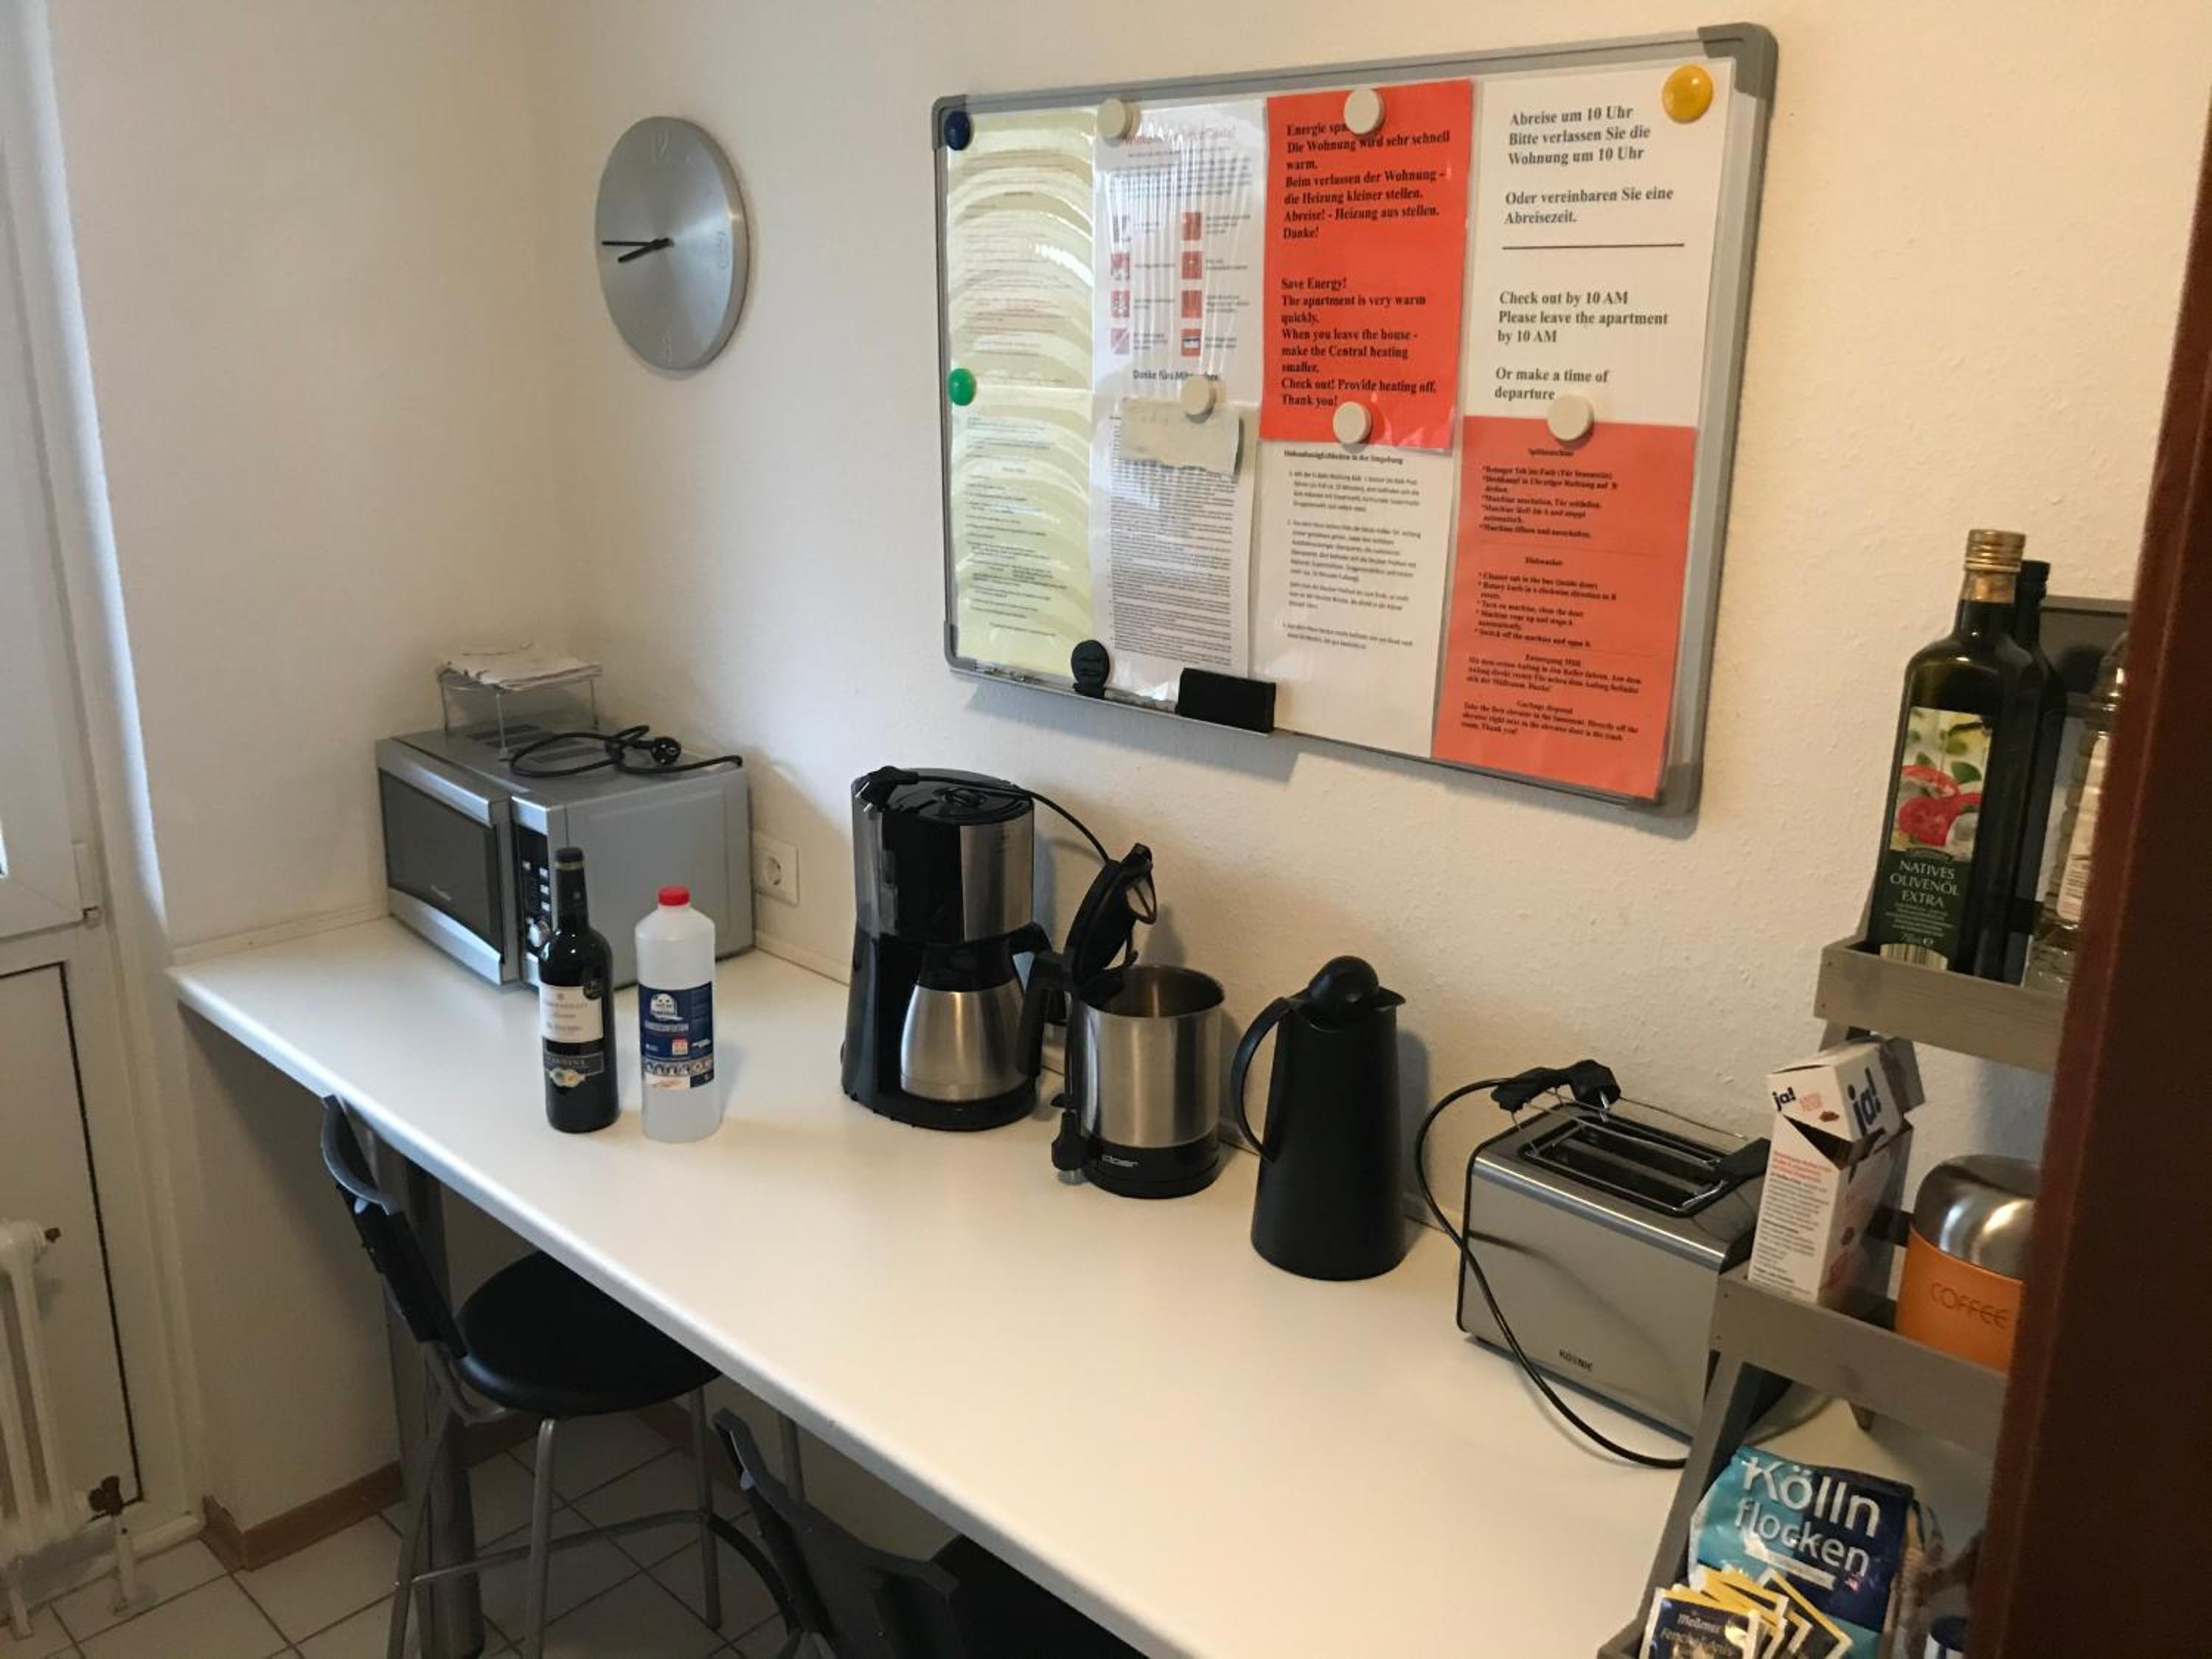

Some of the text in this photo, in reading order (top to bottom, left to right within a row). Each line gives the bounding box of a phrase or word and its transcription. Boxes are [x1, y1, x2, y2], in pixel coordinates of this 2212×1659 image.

[1511, 106, 1633, 125] Abreise um 10 Uhr
[1287, 123, 1326, 136] Energie
[1509, 125, 1650, 145] Bitte verlassen Sie die
[1287, 131, 1450, 153] Die Wohnung wird sehr schnell
[1509, 147, 1645, 166] Wohnung um 10 Uhr
[1287, 161, 1318, 170] warm.
[1286, 177, 1311, 187] Beim
[1314, 175, 1360, 186] verlassen
[1364, 172, 1381, 184] der
[1384, 170, 1436, 183] Wohnung
[1284, 189, 1423, 205] die Heizung kleiner stellen.
[1506, 187, 1674, 205] Oder vereinbaren Sie eine
[1285, 211, 1325, 221] Abreise!
[1335, 208, 1377, 220] Heizung
[1381, 209, 1398, 218] aus
[1402, 206, 1439, 216] stellen.
[1505, 211, 1576, 224] Abreisezeit.
[1284, 228, 1319, 239] Danke!
[1281, 277, 1346, 291] Save Energy!
[1282, 296, 1425, 308] The apartment is very warm
[1499, 292, 1628, 307] Check out by 10 AM
[1281, 313, 1319, 324] quickly.
[1499, 310, 1668, 327] Please leave the apartment
[1282, 329, 1310, 339] When
[1313, 331, 1330, 342] you
[1335, 329, 1358, 339] leave
[1362, 329, 1377, 339] the
[1381, 330, 1410, 339] house
[1498, 330, 1557, 344] by 10 AM
[1282, 347, 1408, 358] make the Central heating
[1282, 363, 1319, 373] smaller.
[1496, 367, 1609, 382] Or make a time of
[1281, 379, 1436, 394] Check out! Provide heating off.
[1282, 395, 1338, 408] Thank you!
[1899, 860, 1955, 879] NATIVES
[1890, 873, 1958, 896] OLIVENÖL
[1902, 890, 1944, 908] EXTRA
[1772, 1086, 1796, 1113] ja!
[1848, 1067, 1883, 1135] ja!
[1930, 1281, 2009, 1329] COFFEE
[1742, 1456, 1881, 1540] Kölln
[1733, 1496, 1871, 1579] flocken
